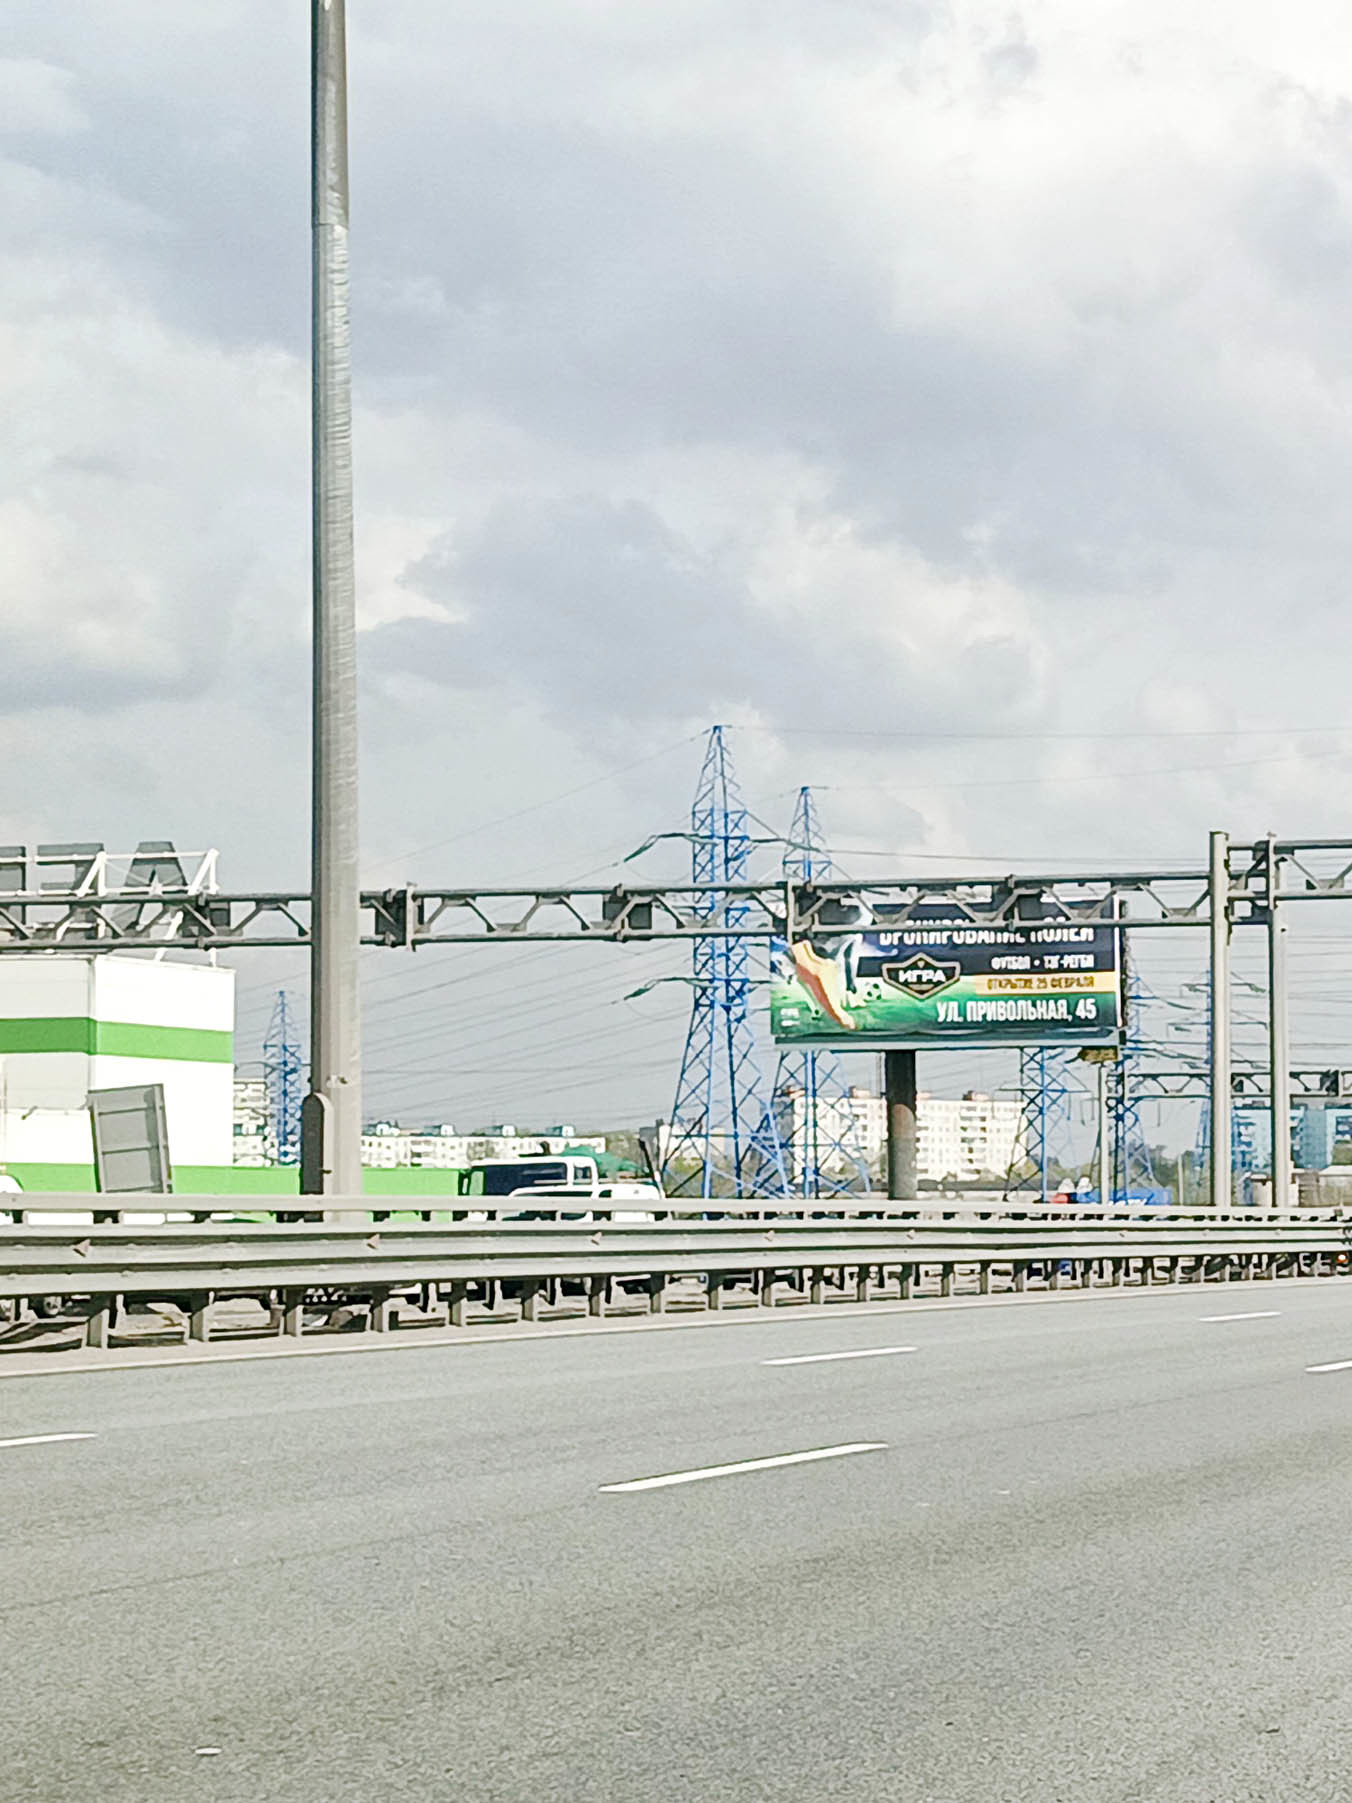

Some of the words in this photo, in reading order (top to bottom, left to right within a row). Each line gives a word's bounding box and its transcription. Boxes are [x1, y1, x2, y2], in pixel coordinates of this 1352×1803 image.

[898, 970, 946, 983] ИГРА
[936, 1001, 963, 1022] УЛ.
[966, 999, 1073, 1022] ПРИВОЛЬНАЯ,
[1075, 998, 1097, 1019] 45
